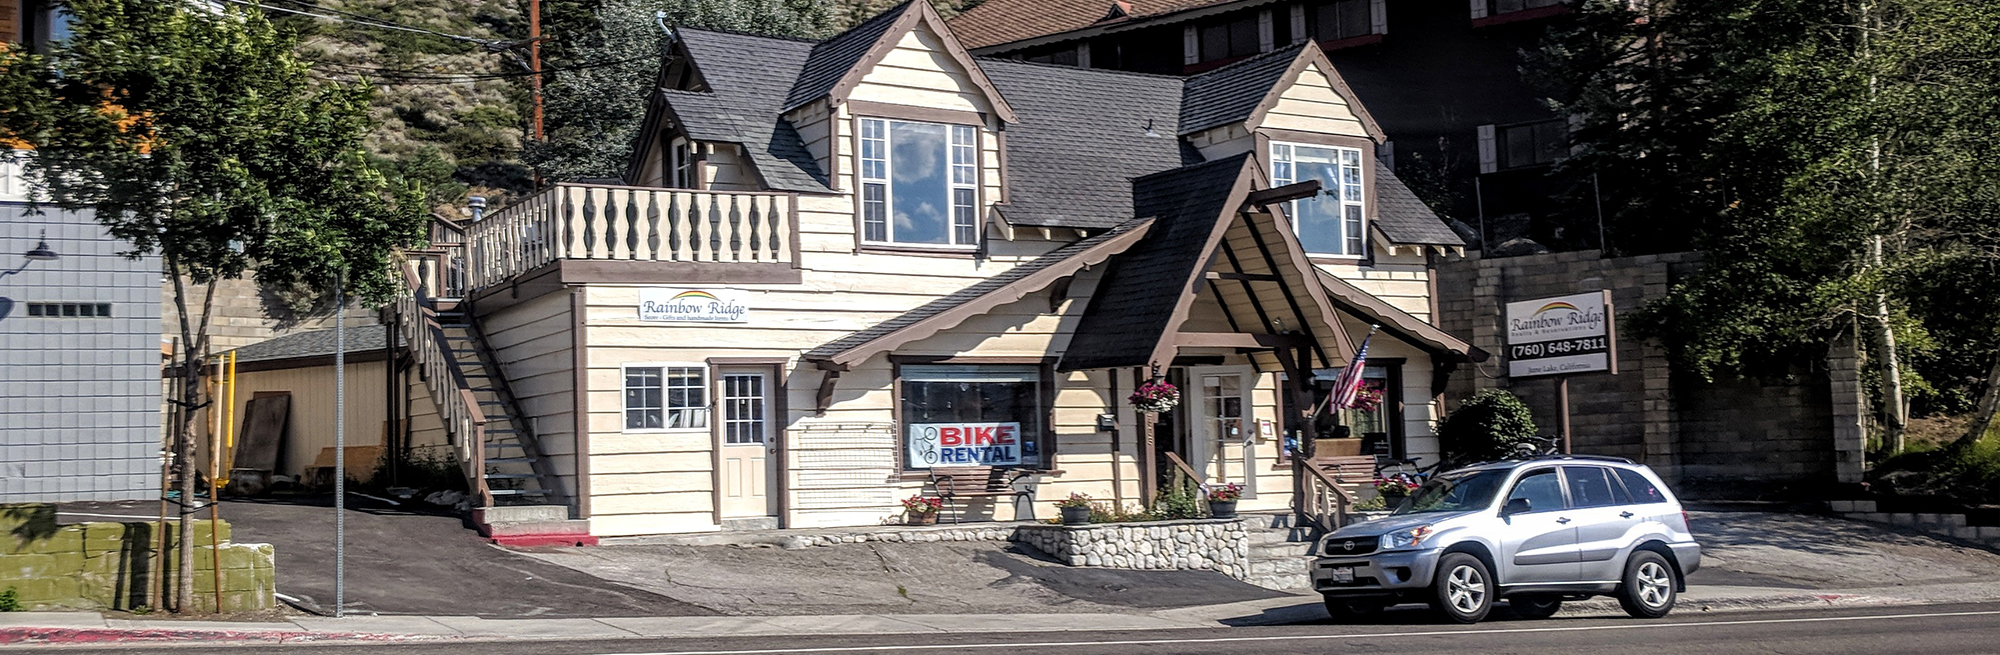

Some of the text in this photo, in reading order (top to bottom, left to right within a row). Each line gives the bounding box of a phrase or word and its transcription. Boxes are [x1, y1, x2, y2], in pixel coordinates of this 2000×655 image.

[643, 298, 745, 321] Rainbow Ridge
[1510, 306, 1603, 332] Rainbow Ridge
[1512, 337, 1607, 359] (760) 648-7811
[940, 425, 1016, 447] BIKE
[940, 446, 1016, 463] RENTAL
